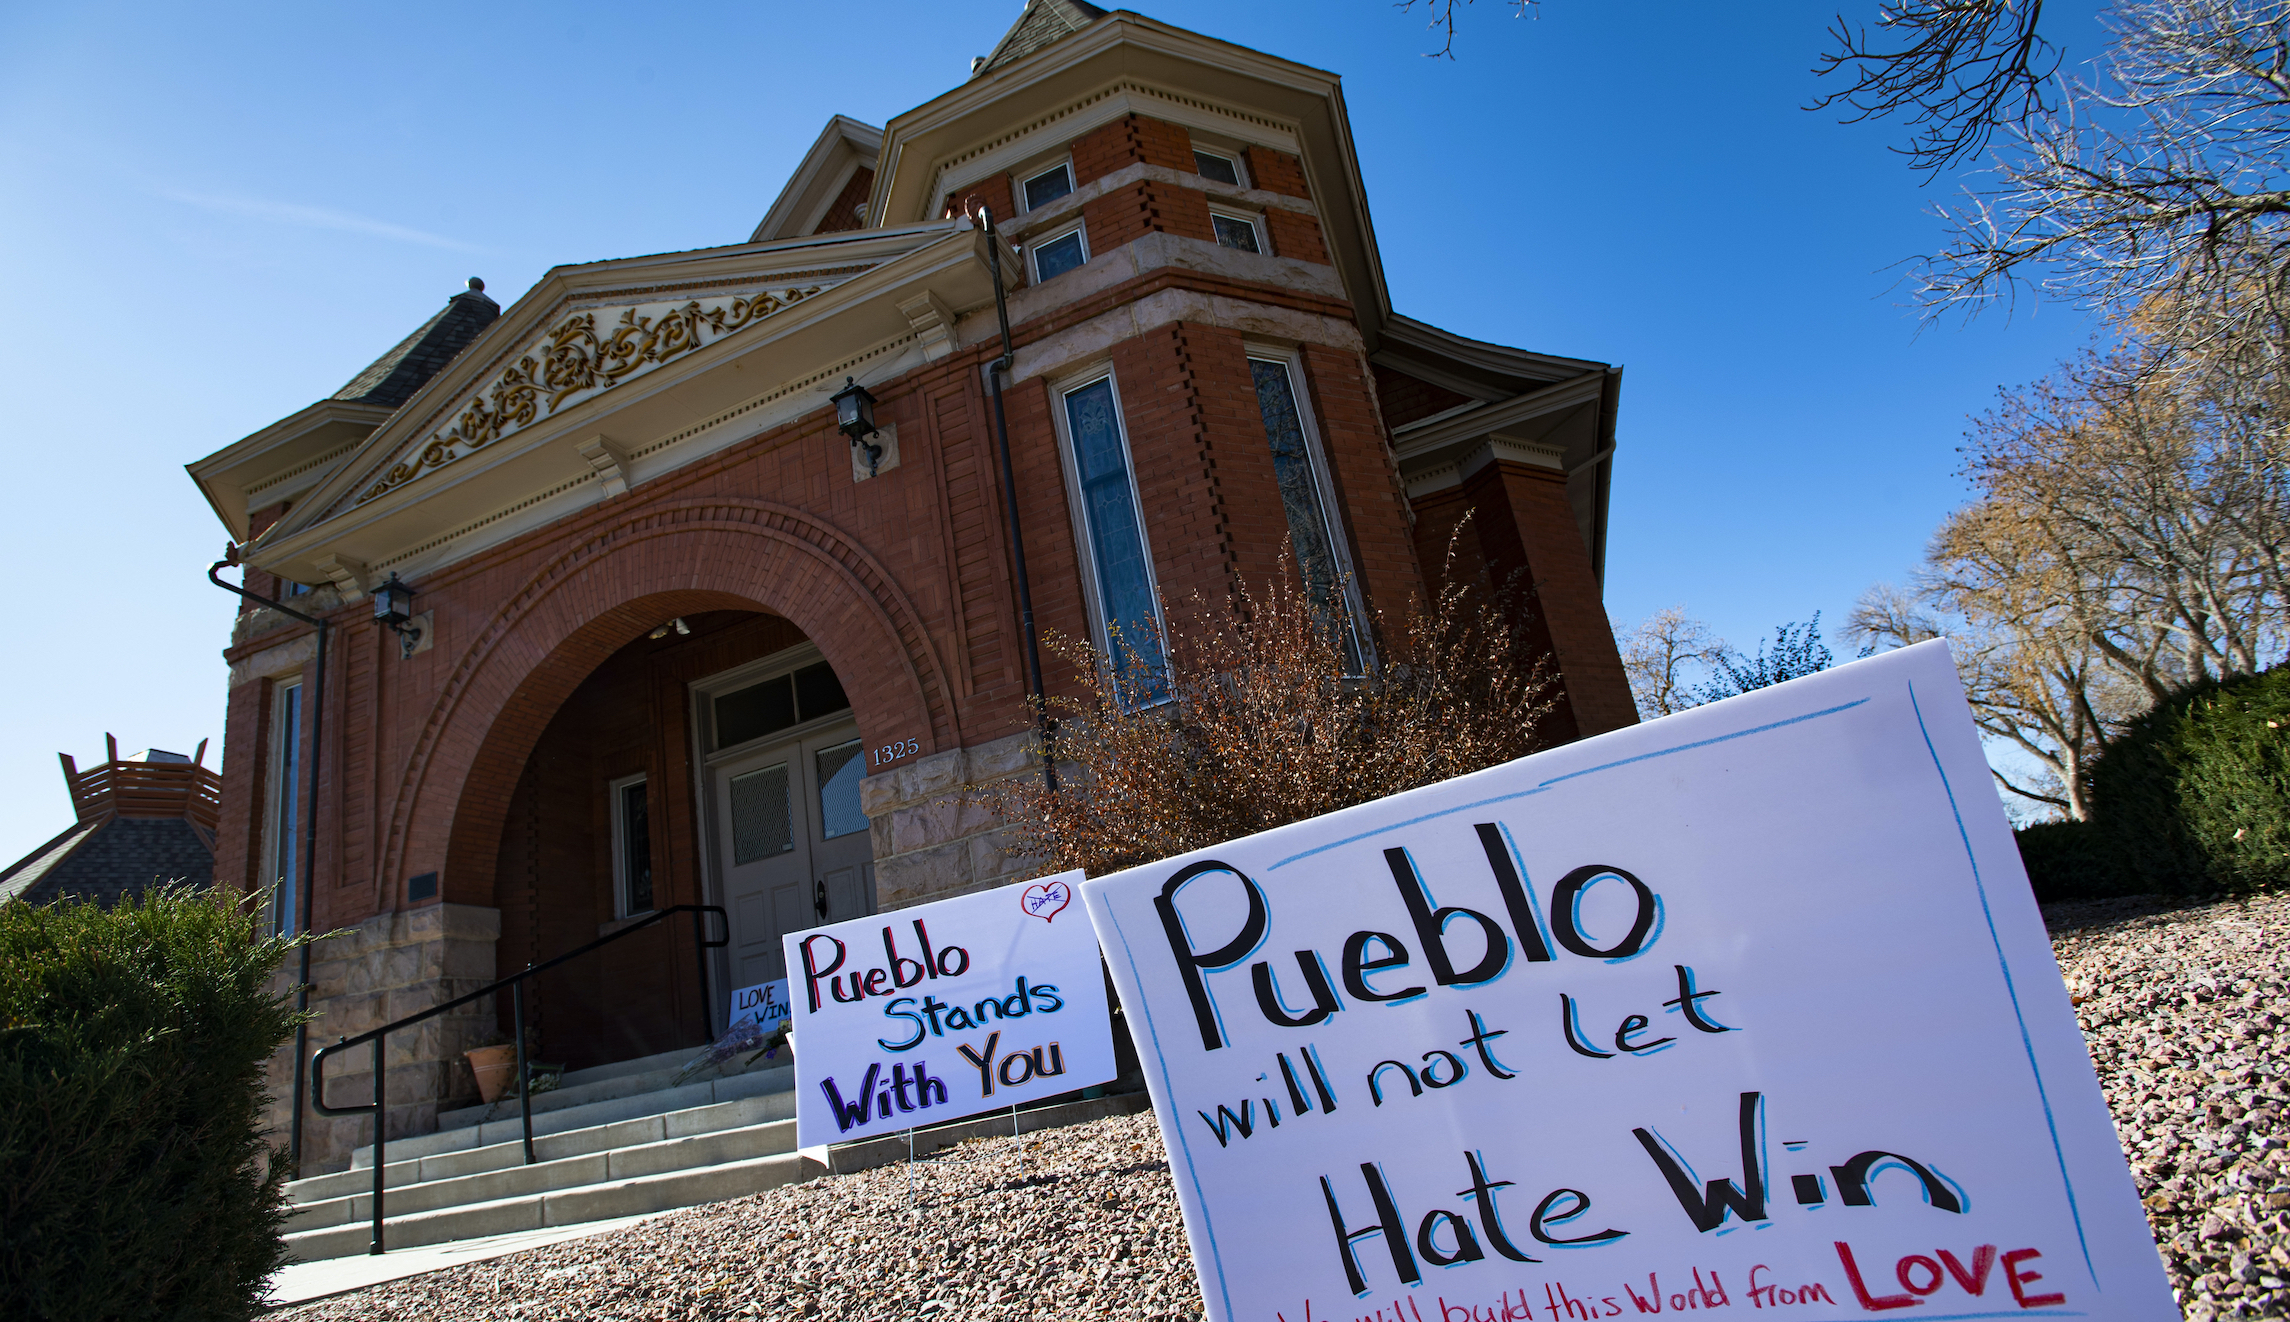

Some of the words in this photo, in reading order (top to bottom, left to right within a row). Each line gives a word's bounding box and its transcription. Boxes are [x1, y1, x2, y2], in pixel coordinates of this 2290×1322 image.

[873, 737, 919, 766] 1325
[1030, 889, 1062, 910] HATE
[1153, 821, 1666, 1051] Pueblo
[739, 985, 775, 1010] LOVE
[799, 918, 969, 1014] Pueblo
[754, 1001, 791, 1024] WIN
[878, 975, 1064, 1053] Stands
[820, 1061, 948, 1134] With
[957, 1031, 1066, 1098] You
[1198, 1043, 1338, 1148] will
[1367, 1010, 1521, 1107] not
[1320, 1149, 1631, 1297] Hate
[1632, 1091, 1971, 1236] Win
[1545, 1281, 1622, 1322] this
[1746, 1264, 1837, 1309] from
[1834, 1241, 2066, 1312] LOVE
